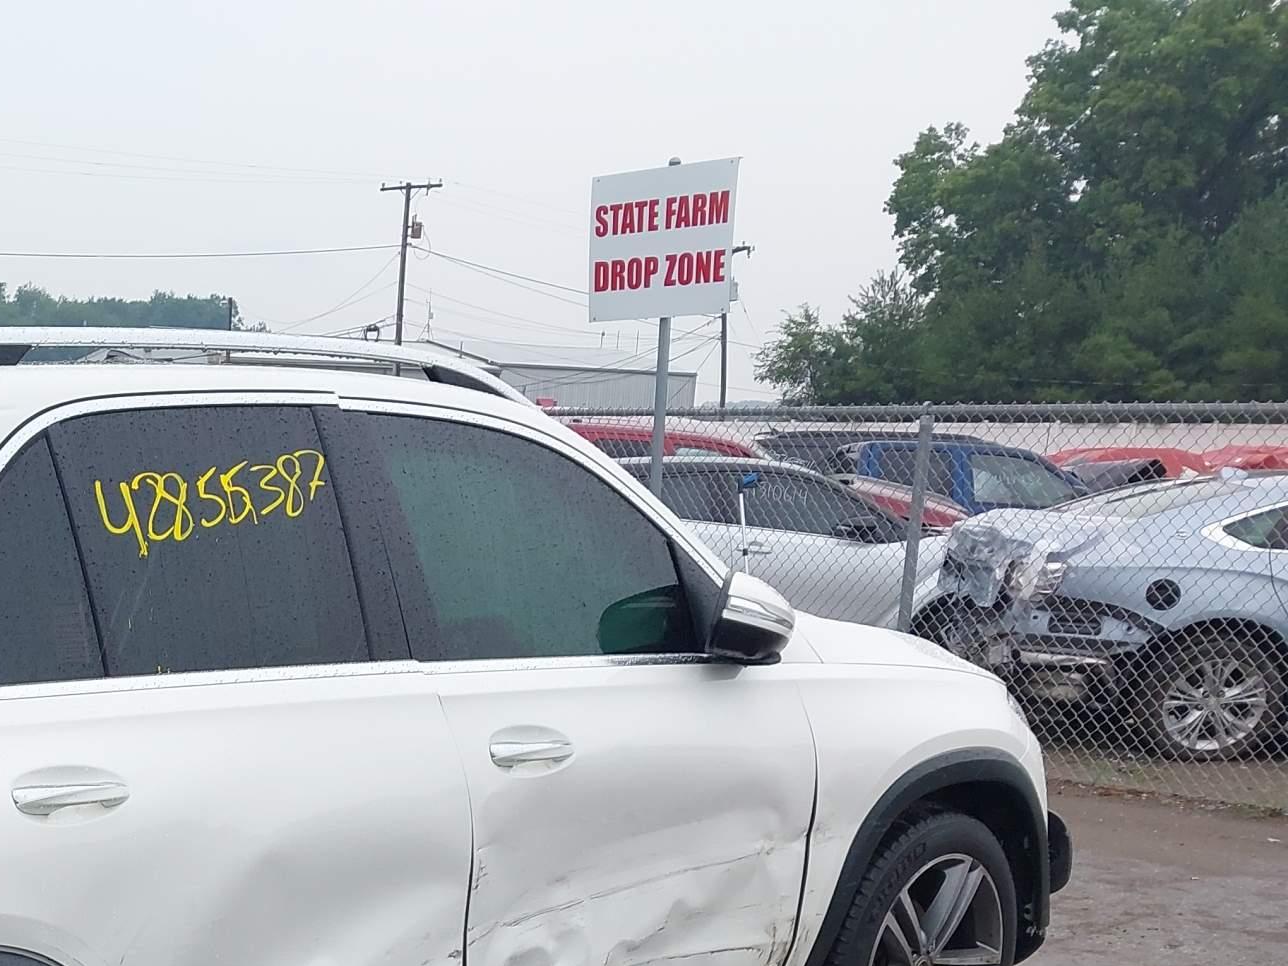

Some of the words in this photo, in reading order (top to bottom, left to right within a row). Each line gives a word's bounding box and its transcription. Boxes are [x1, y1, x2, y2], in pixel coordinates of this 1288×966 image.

[595, 199, 660, 238] STATE
[665, 190, 730, 230] FARM
[594, 256, 659, 293] DROP
[664, 248, 726, 287] ZONE
[95, 449, 326, 558] 42855387
